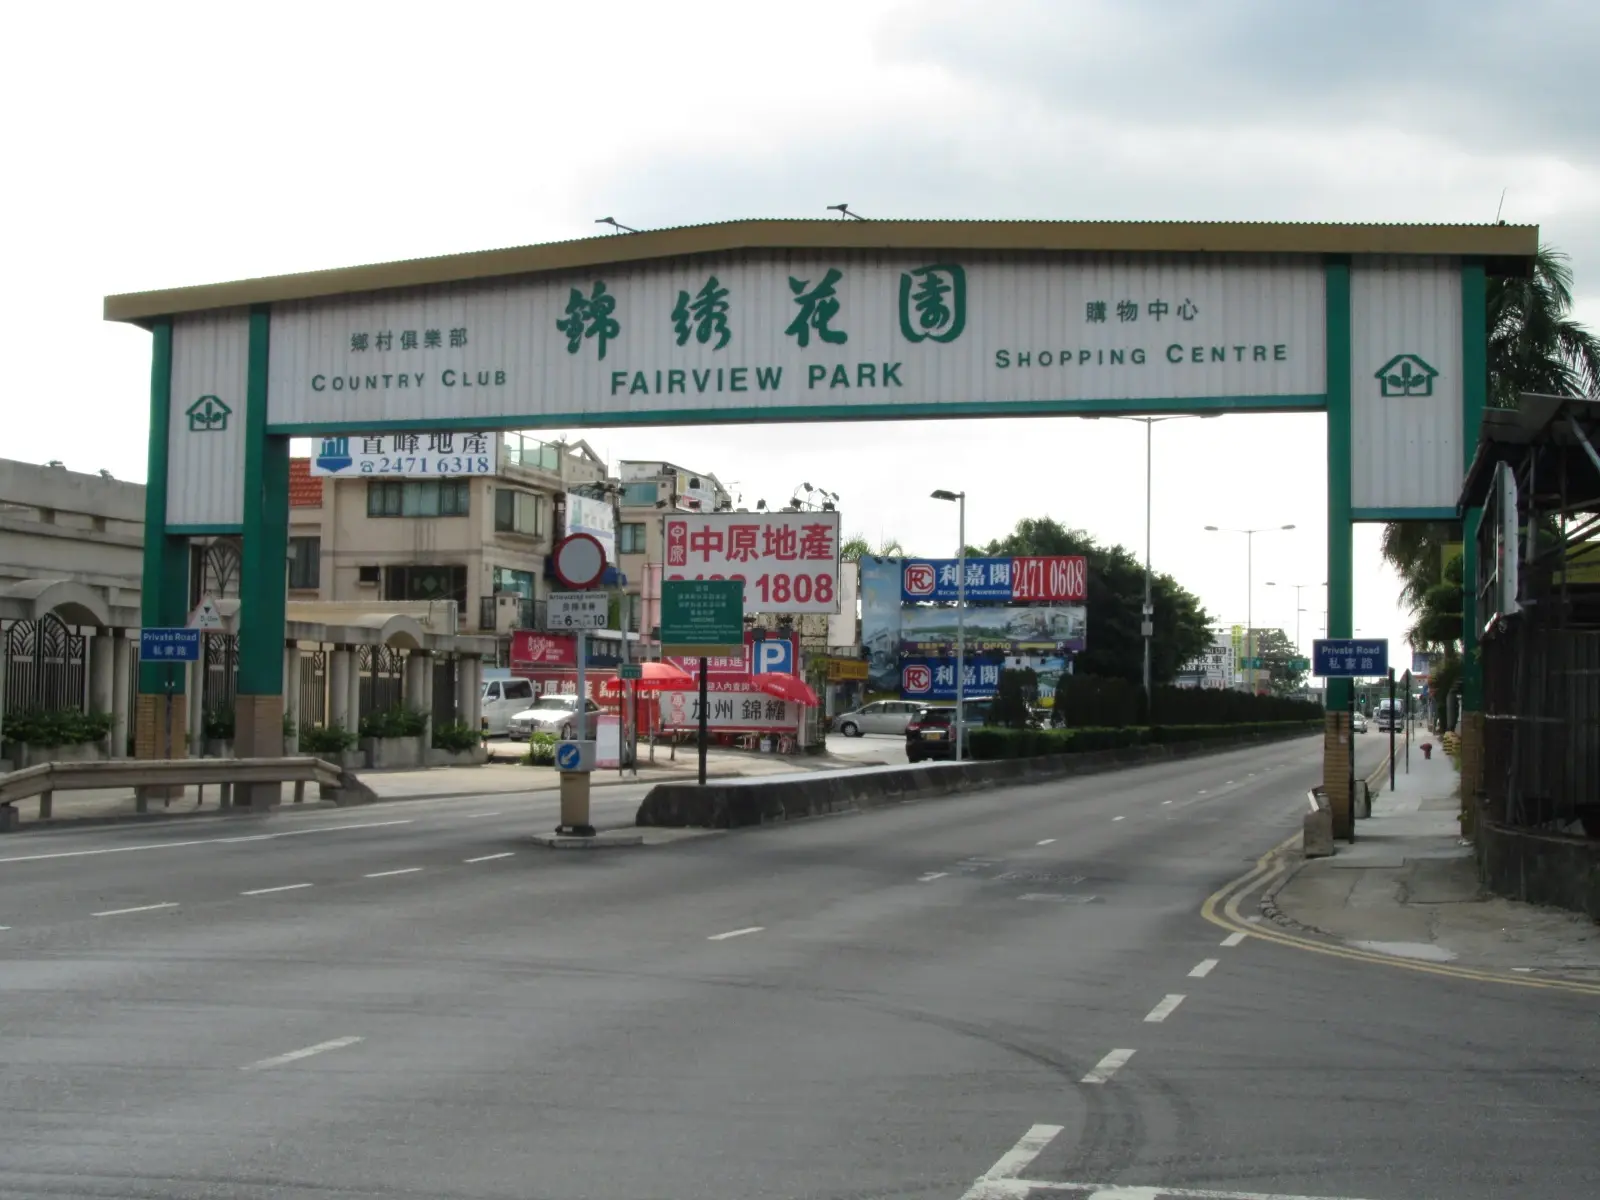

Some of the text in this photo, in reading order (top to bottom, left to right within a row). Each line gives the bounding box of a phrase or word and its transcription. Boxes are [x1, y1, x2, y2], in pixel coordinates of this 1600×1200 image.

[1085, 298, 1199, 323] 購物中心
[350, 328, 468, 352] 鄉村俱樂部
[995, 343, 1287, 369] SHOPPING CENTRE
[312, 369, 507, 392] COUNTRY CLUB
[611, 361, 903, 396] FAIRVIEW PARK
[379, 456, 489, 474] 2471 6318
[690, 523, 834, 563] 中原地產
[939, 563, 1010, 587] 利嘉閣
[1012, 559, 1083, 598] 2471 0608
[755, 573, 834, 604] 1808
[593, 614, 605, 626] 10
[143, 632, 197, 641] Private Road
[1322, 645, 1380, 655] Private Road
[1328, 657, 1373, 670] 私家路
[934, 665, 999, 686] 利嘉閣
[691, 699, 733, 721] 加州
